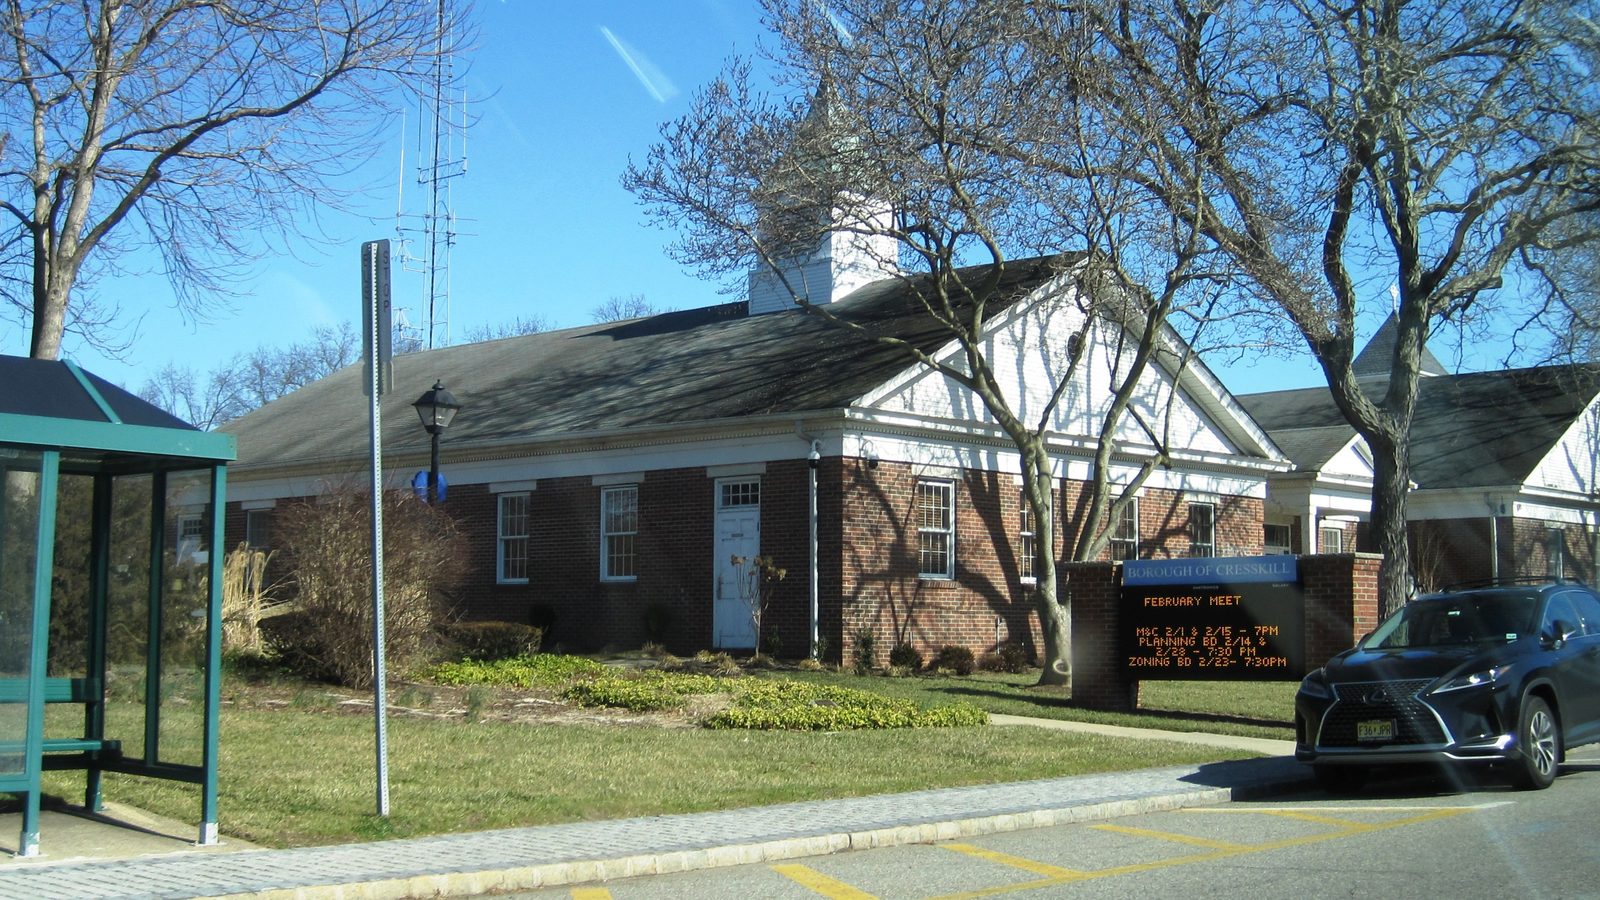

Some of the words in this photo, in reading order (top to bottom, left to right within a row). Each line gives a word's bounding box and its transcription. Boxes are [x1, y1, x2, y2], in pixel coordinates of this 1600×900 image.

[1128, 565, 1191, 578] BOROUGH
[1195, 565, 1213, 576] OF
[1216, 562, 1290, 576] CRESSKILL
[1144, 596, 1202, 607] FEBRUARY
[1209, 595, 1242, 606] MEET
[1136, 627, 1159, 637] M&C
[1165, 626, 1185, 637] 2/1
[1205, 626, 1232, 637] 2/15
[1254, 625, 1280, 636] 7PM
[1139, 636, 1196, 647] PLANNING
[1202, 636, 1218, 647] BD
[1224, 636, 1251, 647] 2/14
[1155, 647, 1186, 657] 2/28
[1208, 647, 1232, 657] 7:30
[1239, 647, 1256, 657] PM
[1128, 656, 1171, 667] ZONING
[1177, 656, 1192, 667] BD
[1244, 656, 1287, 667] 7:30PM
